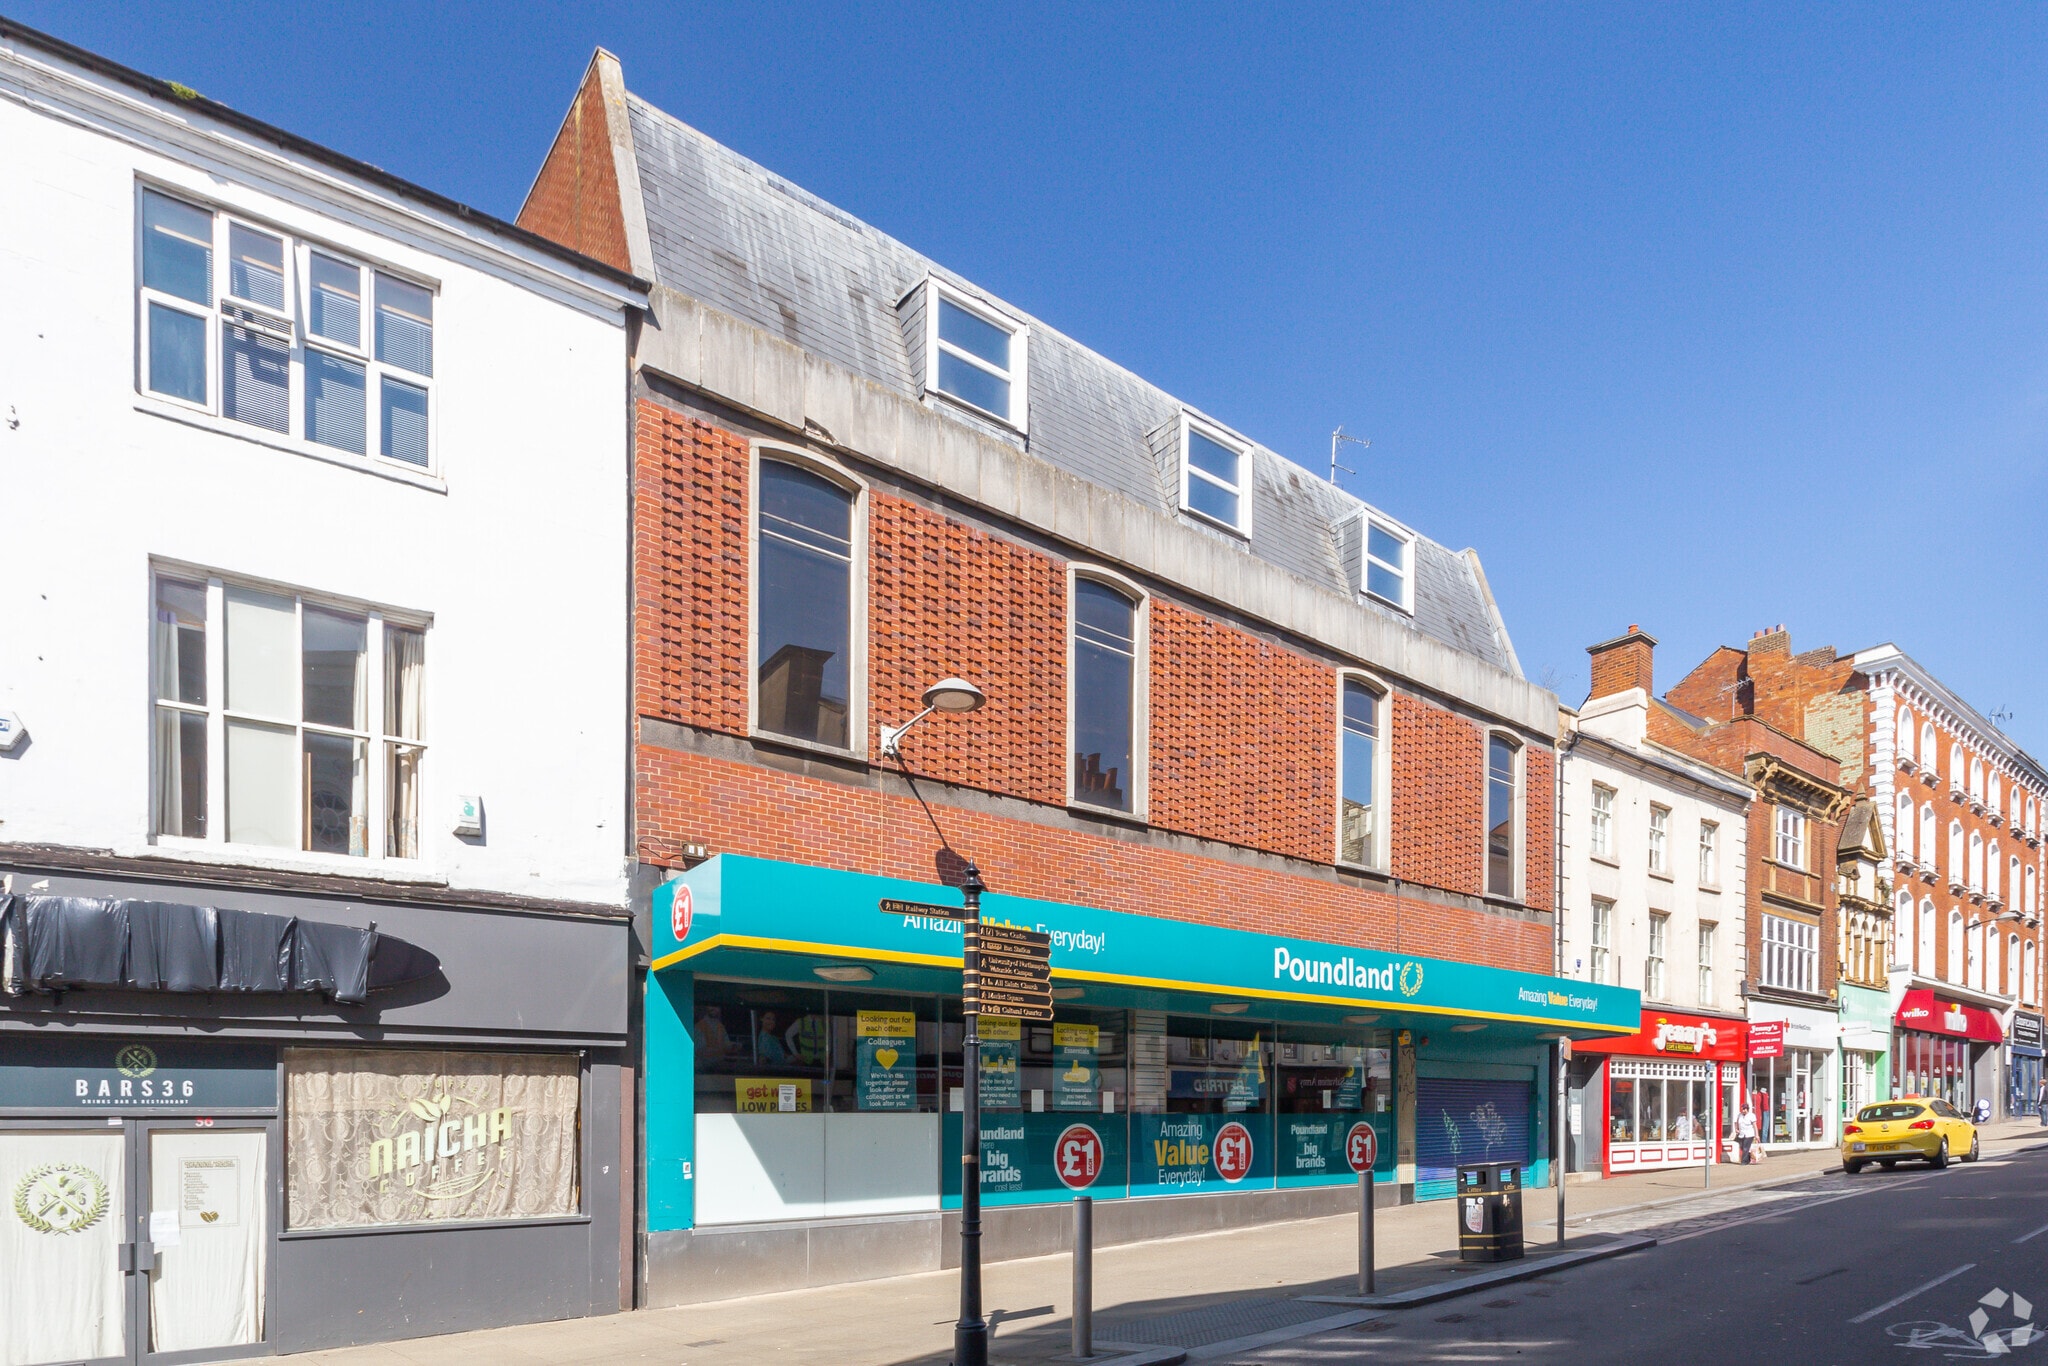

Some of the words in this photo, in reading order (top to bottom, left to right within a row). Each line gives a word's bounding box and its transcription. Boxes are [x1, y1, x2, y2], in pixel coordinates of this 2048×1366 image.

[905, 905, 928, 915] Railway
[929, 907, 950, 916] Station
[1013, 946, 1031, 954] Station
[1013, 968, 1033, 978] Campus
[1273, 947, 1394, 991] Poundland
[994, 977, 1004, 987] All
[1004, 979, 1020, 988] Saints
[1020, 981, 1039, 991] Church
[988, 992, 1006, 1000] Market
[1007, 994, 1024, 1003] Square
[1518, 986, 1548, 1007] Amazing
[1547, 991, 1568, 1006] Value
[1568, 993, 1598, 1012] Everyday!
[1001, 1006, 1022, 1015] Cultural
[1023, 1008, 1043, 1017] Quarter
[1902, 1008, 1929, 1018] wilko
[860, 1014, 888, 1025] Looking
[901, 1015, 912, 1024] for
[977, 1020, 997, 1028] ooking
[865, 1024, 883, 1032] each
[1056, 1026, 1078, 1036] Looking
[867, 1037, 906, 1048] Colleagues
[979, 1040, 1012, 1049] Community
[1063, 1046, 1090, 1055] Essentials
[746, 1083, 769, 1100] get
[770, 1086, 803, 1098] me
[865, 1093, 894, 1101] colleagues
[742, 1102, 767, 1112] LOW
[980, 1127, 1025, 1140] undland
[1160, 1120, 1203, 1140] Amazing
[1290, 1124, 1328, 1135] Poundland
[1154, 1139, 1209, 1167] Value
[1220, 1136, 1246, 1171] £1
[1303, 1142, 1318, 1157] big
[1351, 1134, 1372, 1164] £1
[987, 1150, 1009, 1169] big
[1062, 1139, 1095, 1177] £1
[1296, 1155, 1326, 1169] brands
[379, 1146, 507, 1194] COFFEE
[1158, 1167, 1206, 1188] Everyday!
[994, 1183, 1008, 1192] cost
